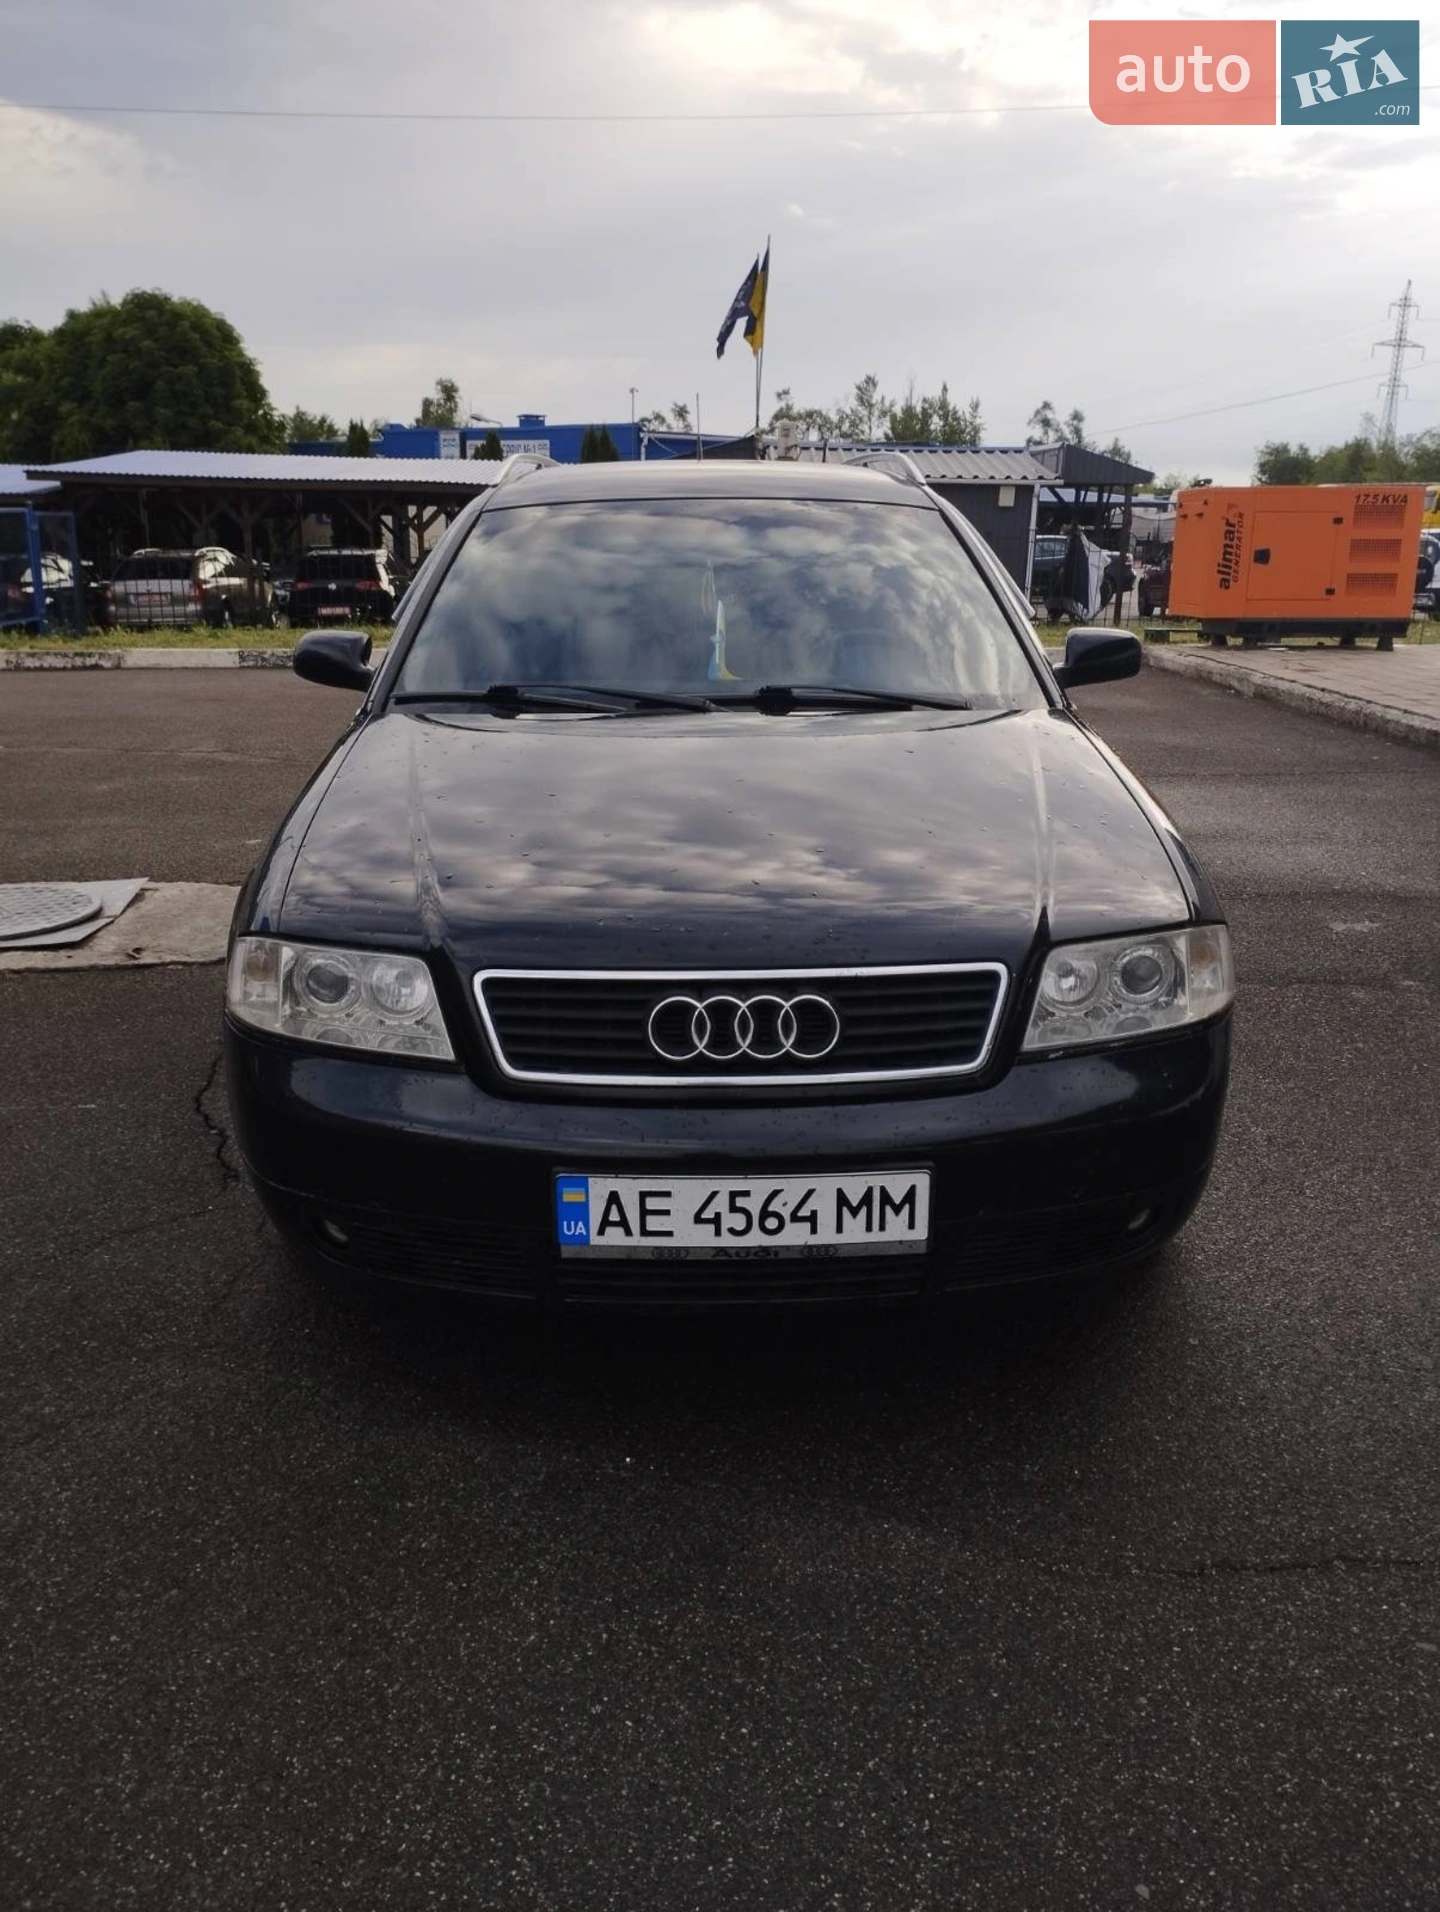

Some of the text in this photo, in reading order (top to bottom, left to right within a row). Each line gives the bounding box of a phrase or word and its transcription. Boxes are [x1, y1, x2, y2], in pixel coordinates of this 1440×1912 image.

[1216, 517, 1237, 591] alimar
[1232, 511, 1245, 583] GENERATOR
[563, 1221, 588, 1237] UA
[596, 1183, 917, 1238] AE 4564 MM
